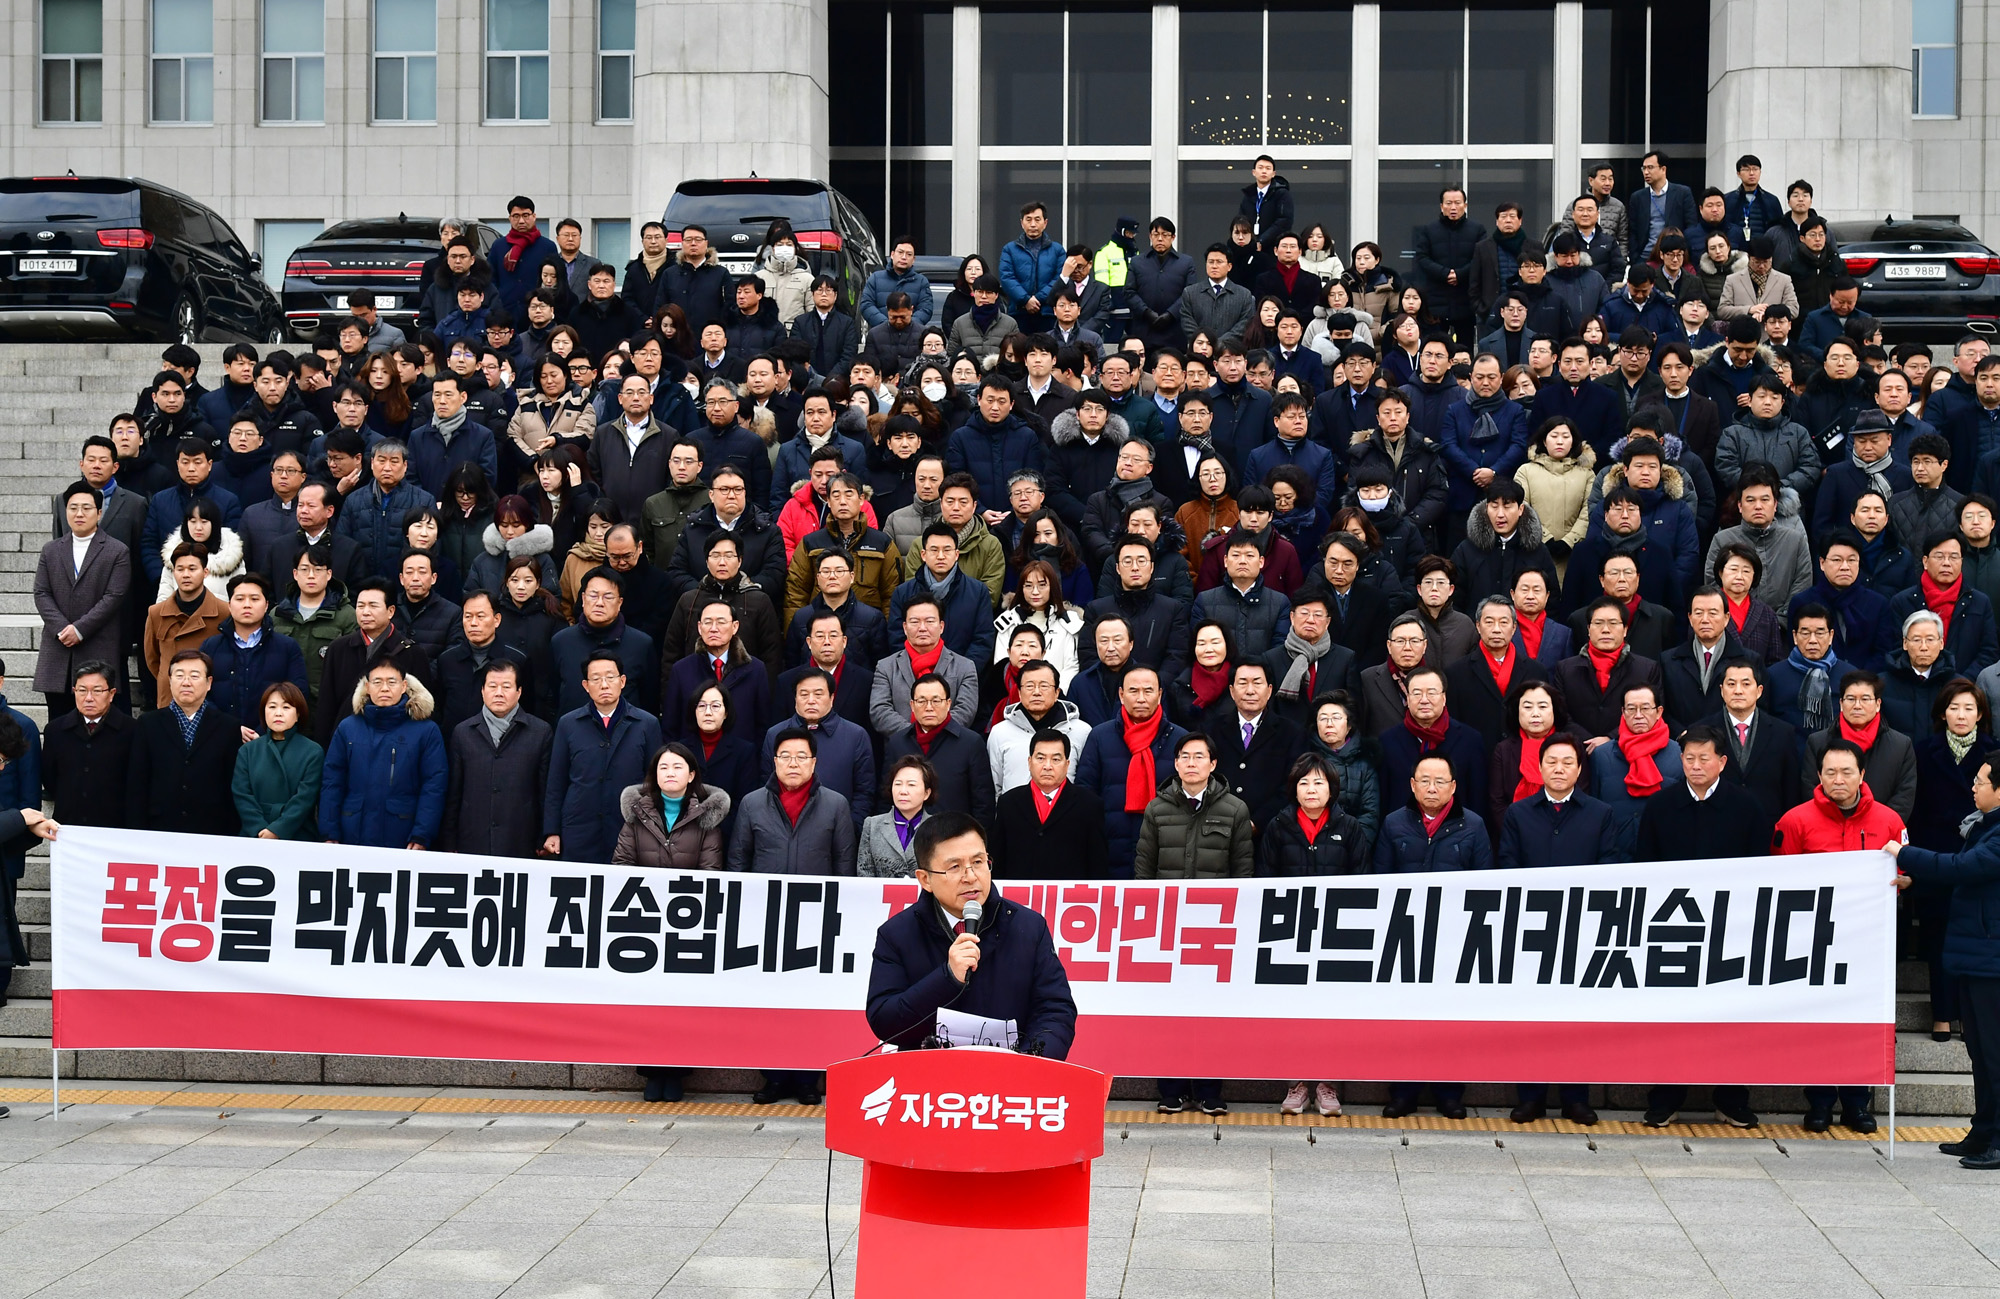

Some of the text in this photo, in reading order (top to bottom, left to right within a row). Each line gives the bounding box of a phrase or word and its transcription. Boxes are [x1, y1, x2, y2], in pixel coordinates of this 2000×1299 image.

[102, 862, 277, 962] 폭정을
[294, 868, 529, 968] 막지못해
[544, 875, 855, 975] 죄송합니다.
[1254, 886, 1443, 985] 반드시
[1455, 886, 1848, 989] 지키겠습니다.
[899, 1092, 1070, 1132] 자유한국당
